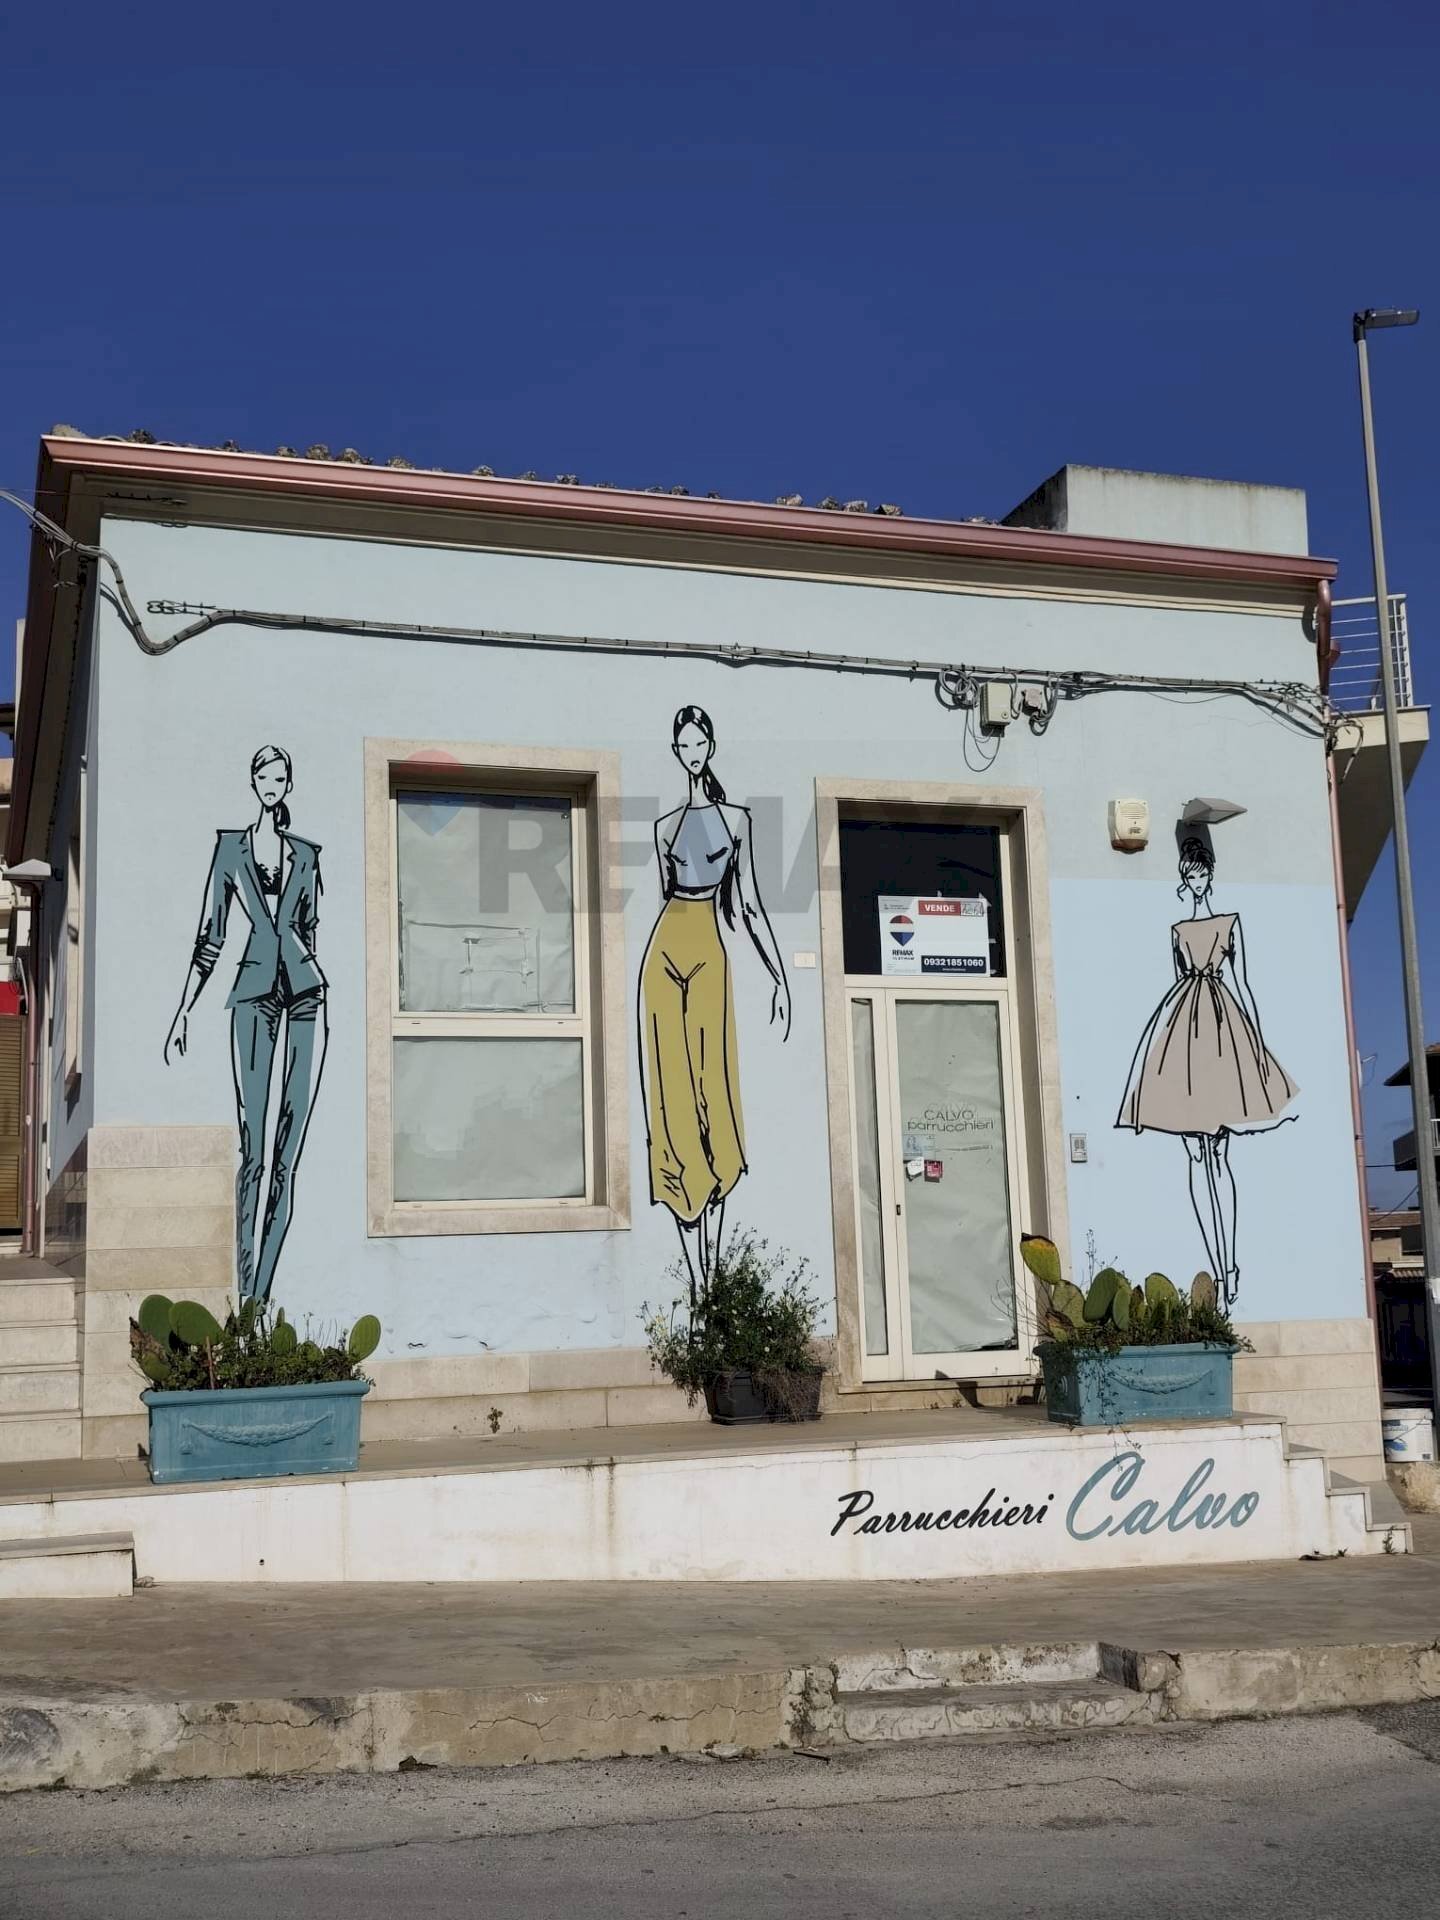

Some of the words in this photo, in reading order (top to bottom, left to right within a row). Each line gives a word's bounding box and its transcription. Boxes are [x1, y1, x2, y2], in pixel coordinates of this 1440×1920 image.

[924, 904, 955, 913] VENDE
[923, 957, 984, 967] 09321851060
[924, 1109, 974, 1122] CALVO
[907, 1119, 994, 1133] parrucchieri
[830, 1487, 1055, 1537] Parrucchieri
[1066, 1451, 1260, 1542] Calvo
